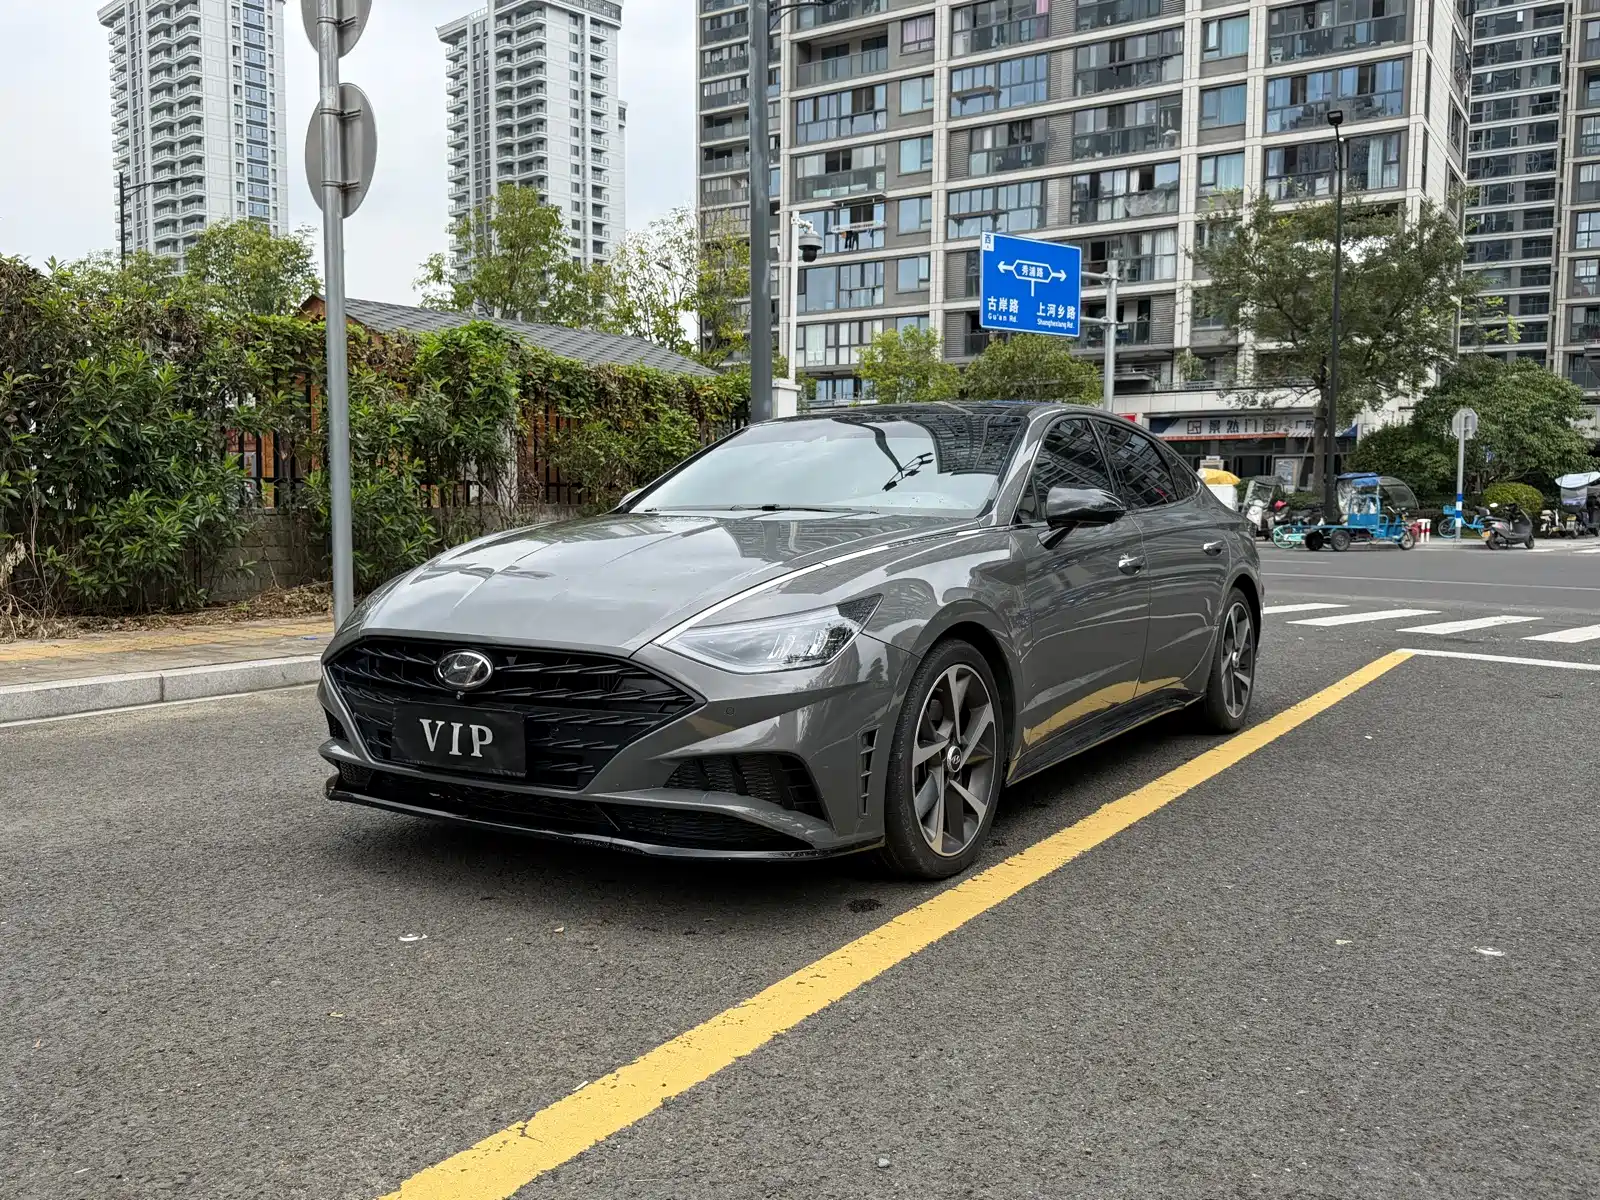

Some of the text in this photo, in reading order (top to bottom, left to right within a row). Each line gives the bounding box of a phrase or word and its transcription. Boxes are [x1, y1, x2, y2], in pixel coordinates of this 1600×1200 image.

[987, 296, 1019, 313] 古岸路
[1036, 302, 1076, 320] 上河乡路
[987, 313, 1018, 322] Gu'an Rd.
[419, 718, 494, 757] VIP
